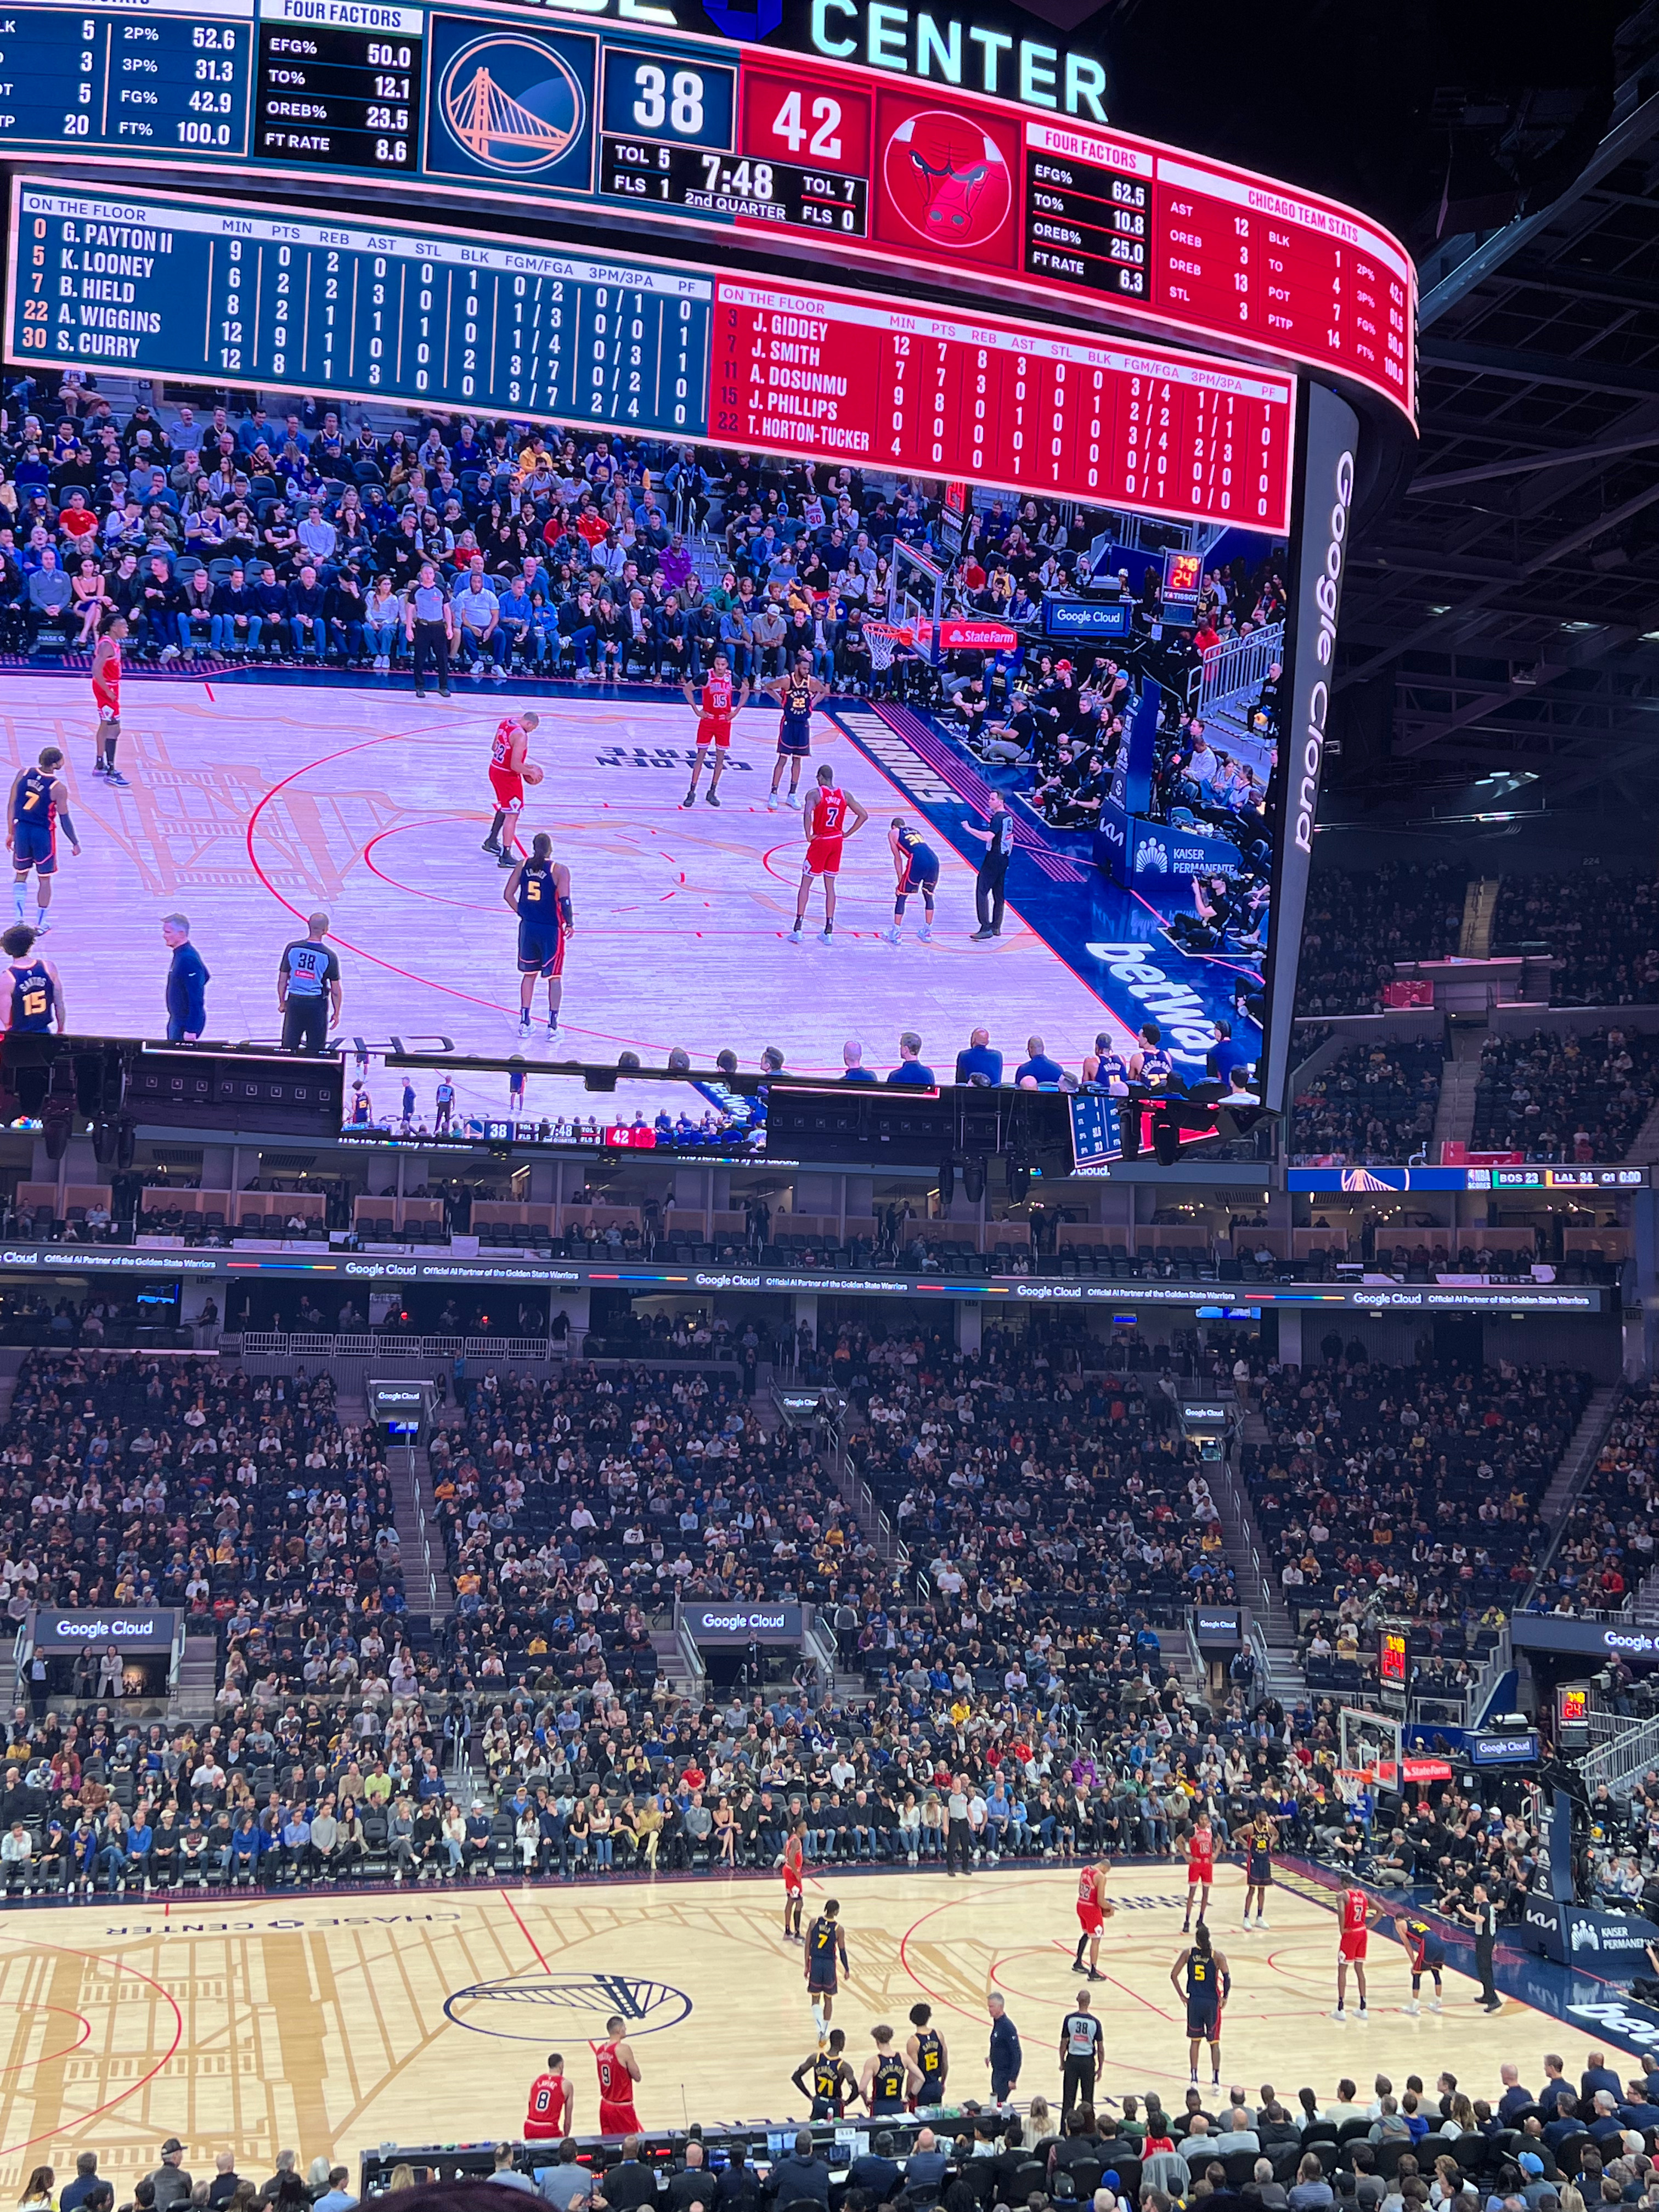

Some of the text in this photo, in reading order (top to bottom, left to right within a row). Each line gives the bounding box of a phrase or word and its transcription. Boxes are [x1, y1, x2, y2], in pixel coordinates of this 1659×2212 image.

[284, 0, 402, 28] FOUR FACTORS
[124, 26, 235, 50] 2P% 52.6
[270, 37, 411, 67] EFG% 50.0
[811, 0, 1109, 122] CENTER
[122, 58, 233, 82] 3P% 31.3
[268, 69, 410, 99] TO% 12.1
[121, 89, 232, 113] FG% 42.9
[634, 65, 703, 133] 38
[267, 101, 408, 130] OREB% 23.5
[772, 91, 842, 160] 42
[119, 121, 230, 145] FT% 100.0
[266, 132, 407, 162] FT RATE 8.6
[615, 144, 670, 169] TOL 5
[1046, 131, 1136, 168] FOUR FACTORS
[614, 174, 669, 199] FLS 1
[702, 154, 773, 200] 7:48
[803, 176, 855, 201] TOL 7
[1035, 163, 1145, 207] EFG% 62.5
[685, 192, 786, 221] 2nd QUARTER
[803, 205, 854, 230] FLS 0
[1034, 193, 1144, 235] TO% 10.8
[1170, 201, 1193, 217] AST
[1249, 190, 1358, 242] CHICAGO TEAM STATS
[29, 197, 696, 293] ON THE FLOOR MIN PTS REB AST STL BLK FGM/FGA 3PM/3PA PF
[63, 221, 173, 253] G. PAYTON II
[1034, 222, 1144, 263] OREB% 25.0
[1170, 229, 1202, 248] OREB
[1269, 231, 1290, 247] BLK
[61, 248, 154, 278] K. LOONEY
[1033, 251, 1143, 292] FT RATE 6.3
[1170, 257, 1201, 276] DREB
[1268, 258, 1283, 272] TO
[60, 275, 135, 303] B. HIELD
[724, 288, 825, 313] ON THE FLOOR
[1169, 286, 1190, 302] STL
[1268, 286, 1290, 302] POT
[58, 303, 161, 333] A. WIGGINS
[753, 312, 828, 342] J. GIDDEY
[1268, 313, 1293, 330] PITP
[57, 330, 140, 358] S. CURRY
[752, 338, 820, 366] J. SMITH
[749, 363, 847, 397] A. DOSUNMU
[749, 390, 838, 421] J. PHILLIPS
[748, 414, 870, 452] T. HORTON-TUCKER
[1057, 608, 1120, 624] Google Cloud
[1295, 450, 1354, 854] Google Cloud
[835, 712, 964, 804] WARRIORS
[22, 791, 40, 810] 7
[827, 808, 839, 827] 7
[1173, 848, 1204, 861] KAISER
[527, 881, 541, 901] 5
[298, 952, 316, 970] 38
[22, 990, 47, 1016] 15
[489, 1123, 629, 1144] 38 7:48 42
[1474, 1170, 1641, 1184] NBA BOS 23 LAL 34 Q1 0:00
[345, 1262, 385, 1277] Google
[386, 1264, 416, 1276] Cloud
[424, 1267, 449, 1276] Official
[459, 1268, 485, 1277] Partner
[506, 1269, 531, 1278] Golden
[549, 1271, 579, 1279] Warriors
[696, 1273, 760, 1288] Google Cloud
[1353, 1292, 1422, 1306] Google Cloud
[57, 1620, 154, 1639] Google Cloud
[702, 1613, 785, 1630] Google Cloud
[1604, 1630, 1652, 1651] Google
[1382, 1649, 1405, 1679] 24
[1564, 1703, 1582, 1717] 24
[1479, 1740, 1530, 1754] Google Cloud
[106, 1913, 461, 1935] CHASE CENTER
[1601, 1926, 1628, 1938] KAISER
[817, 1933, 828, 1948] 7
[1194, 1965, 1205, 1981] 5
[1075, 2021, 1088, 2034] 38
[924, 2052, 938, 2070] 15
[602, 2066, 610, 2085] 9
[817, 2076, 834, 2096] 71
[885, 2078, 898, 2096] 2
[536, 2090, 550, 2111] 8
